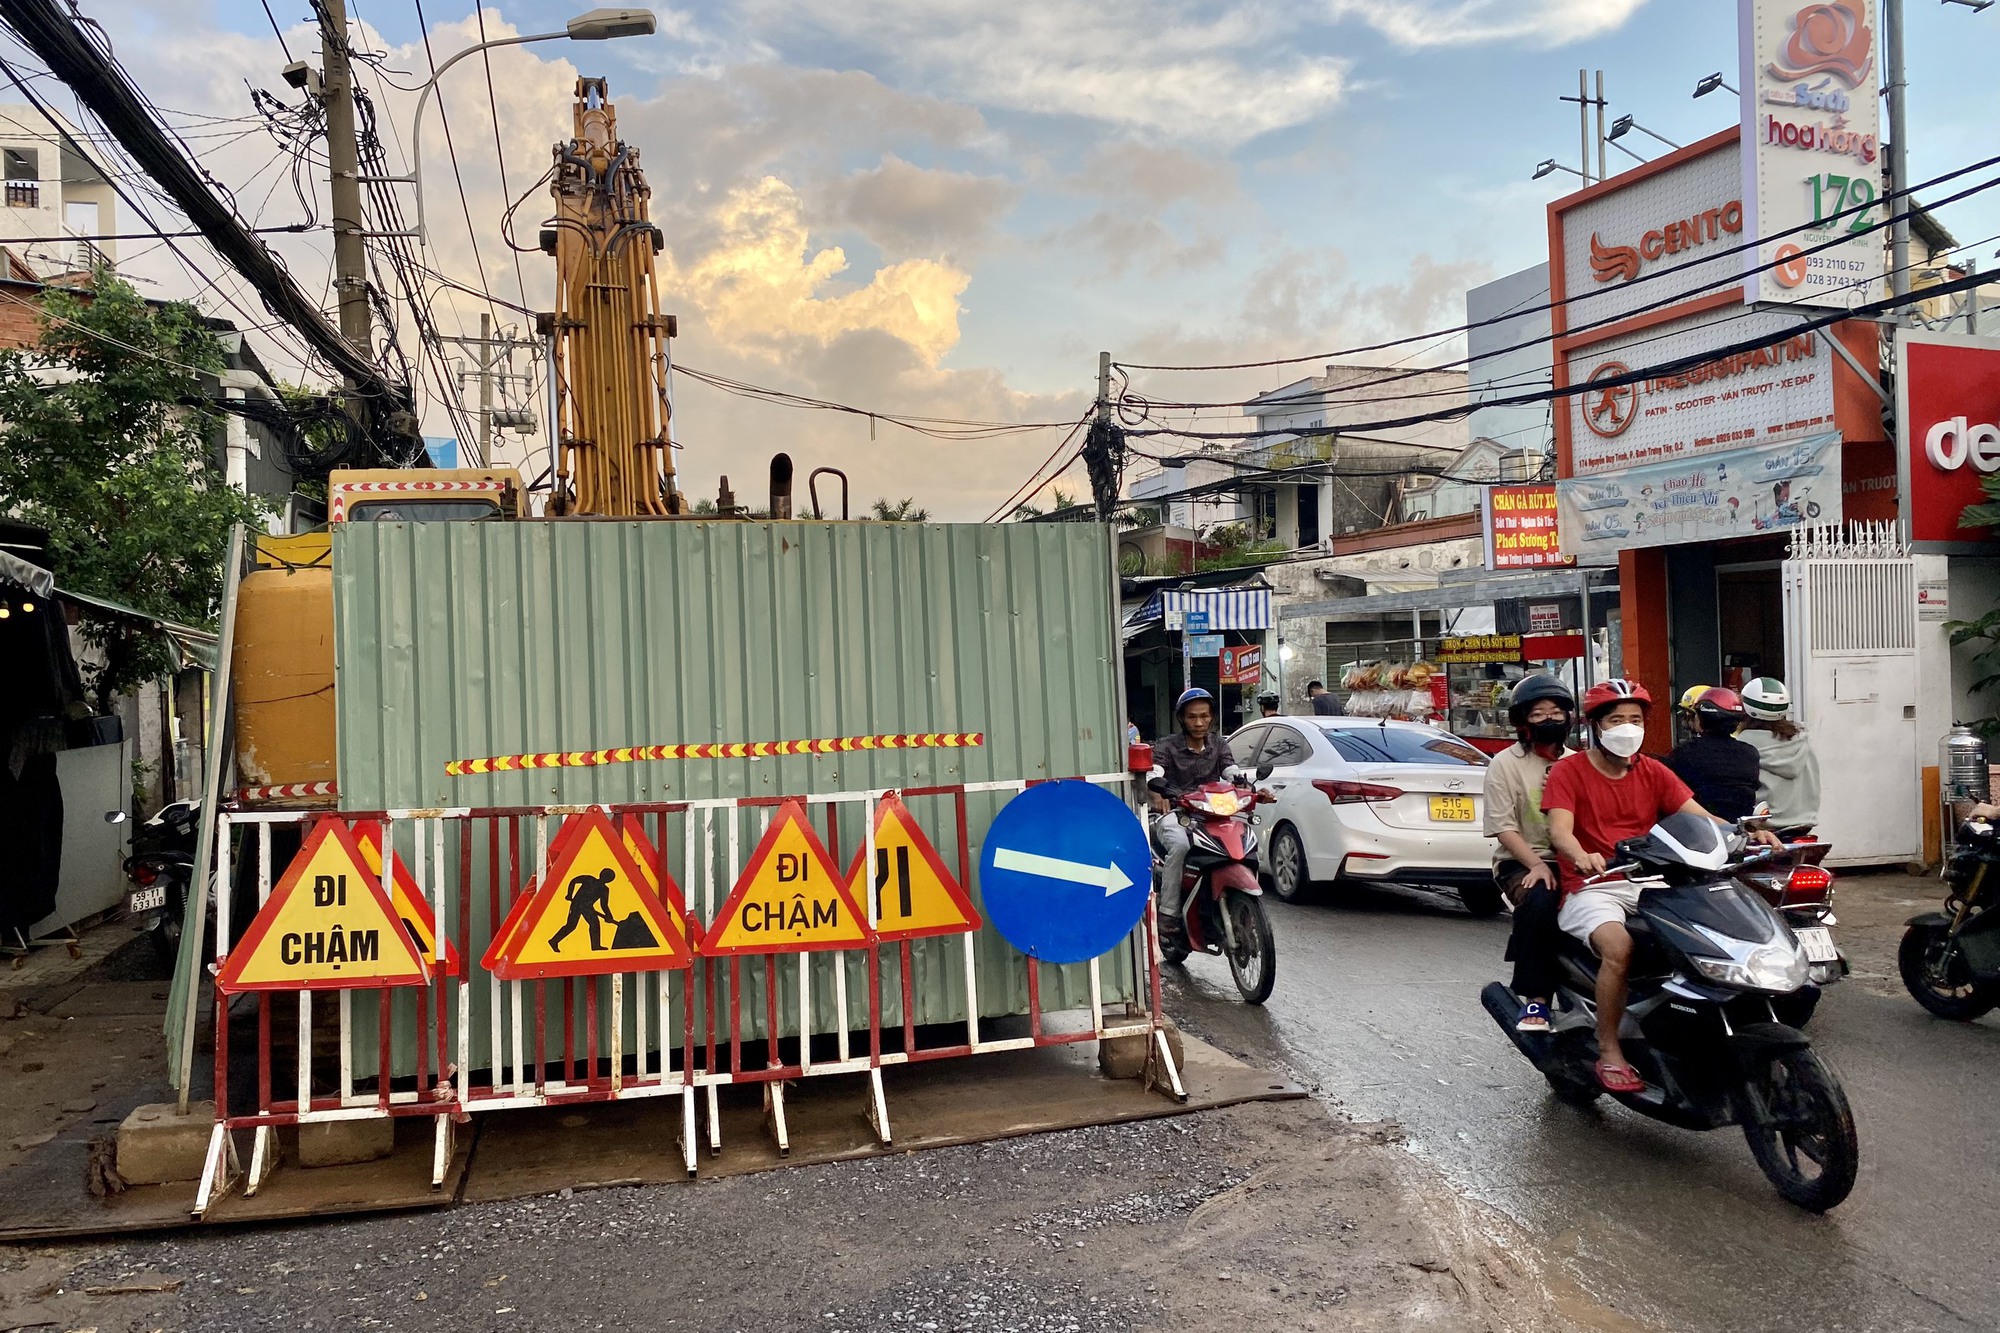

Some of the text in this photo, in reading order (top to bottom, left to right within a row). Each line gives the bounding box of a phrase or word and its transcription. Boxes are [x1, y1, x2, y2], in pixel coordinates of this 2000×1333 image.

[1793, 77, 1849, 112] Sách
[1807, 173, 1874, 234] 172
[1640, 199, 1742, 261] CENTO
[1806, 257, 1865, 272] 093 2110 627
[1806, 273, 1824, 285] 028
[1826, 274, 1850, 288] 3743
[1645, 406, 1668, 417] PATIN
[1675, 396, 1715, 412] SCOOTER
[1741, 382, 1774, 397] TRƯỢT
[1780, 378, 1794, 389] XE
[1694, 437, 1716, 447] Hotline:
[1494, 489, 1559, 511] CHÂN GÀ RÚT XƯ
[1442, 797, 1462, 808] 51G
[1435, 808, 1471, 820] 762.75
[776, 853, 808, 883] ĐI
[136, 888, 159, 902] 59-Y1
[313, 874, 346, 907] ĐI
[133, 896, 163, 911] 633.18
[741, 892, 838, 937] CHẬM
[1794, 930, 1823, 944] 0-N1
[280, 924, 379, 970] CHẬM
[1526, 1003, 1540, 1015] C
[1670, 1002, 1698, 1014] HONDA
